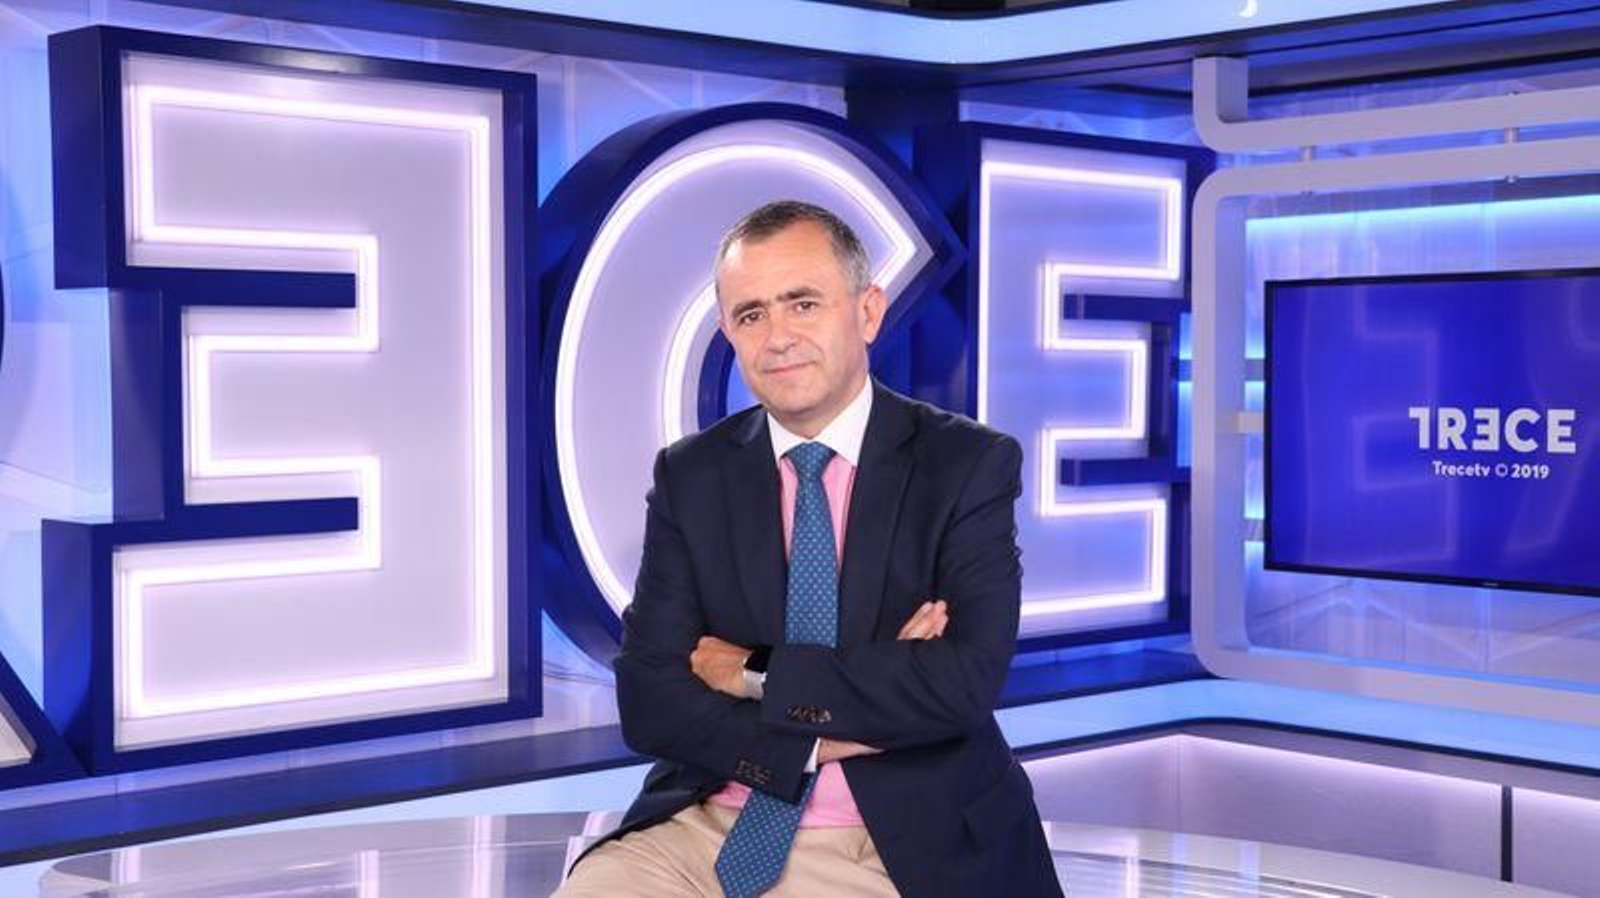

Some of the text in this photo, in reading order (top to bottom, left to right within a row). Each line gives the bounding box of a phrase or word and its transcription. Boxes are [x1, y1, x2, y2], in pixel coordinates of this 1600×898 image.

[1408, 406, 1577, 454] TRECE
[1432, 460, 1490, 478] Trecetv
[1511, 463, 1550, 479] 2019
